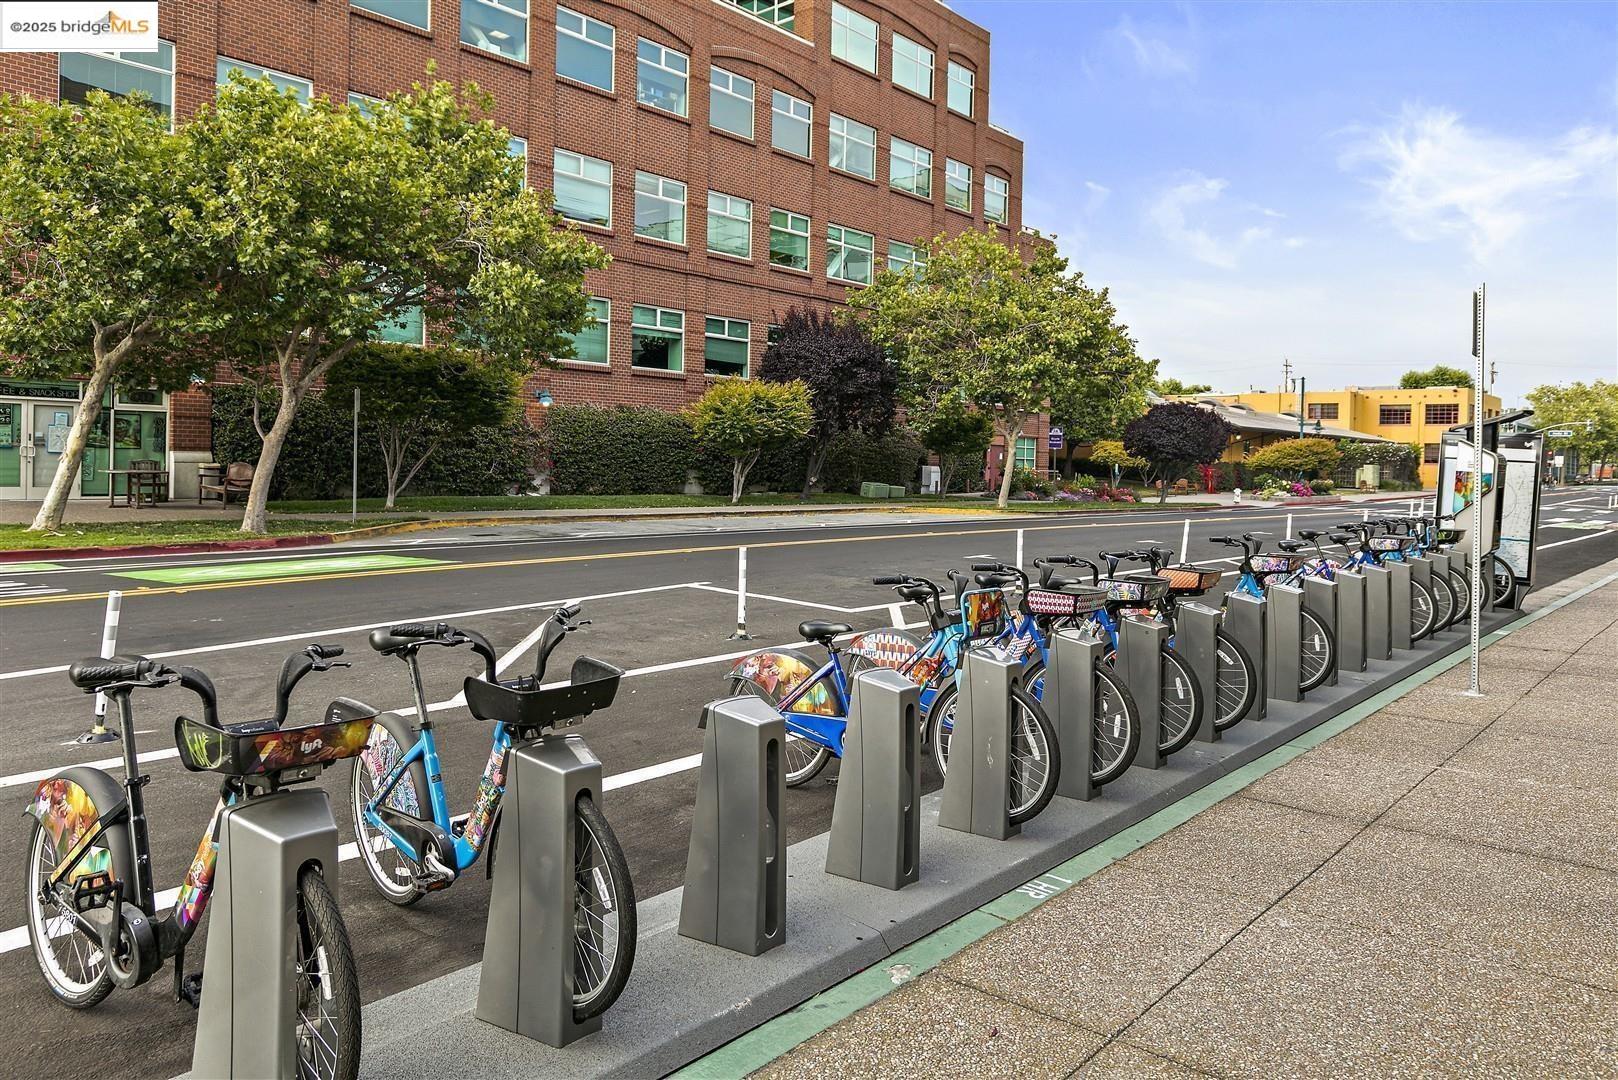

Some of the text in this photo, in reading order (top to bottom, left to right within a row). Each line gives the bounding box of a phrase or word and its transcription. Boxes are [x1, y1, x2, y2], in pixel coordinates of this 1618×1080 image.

[29, 388, 56, 397] SNACK
[57, 390, 79, 398] SHOP
[301, 739, 323, 754] lyft
[1016, 881, 1061, 900] HR
